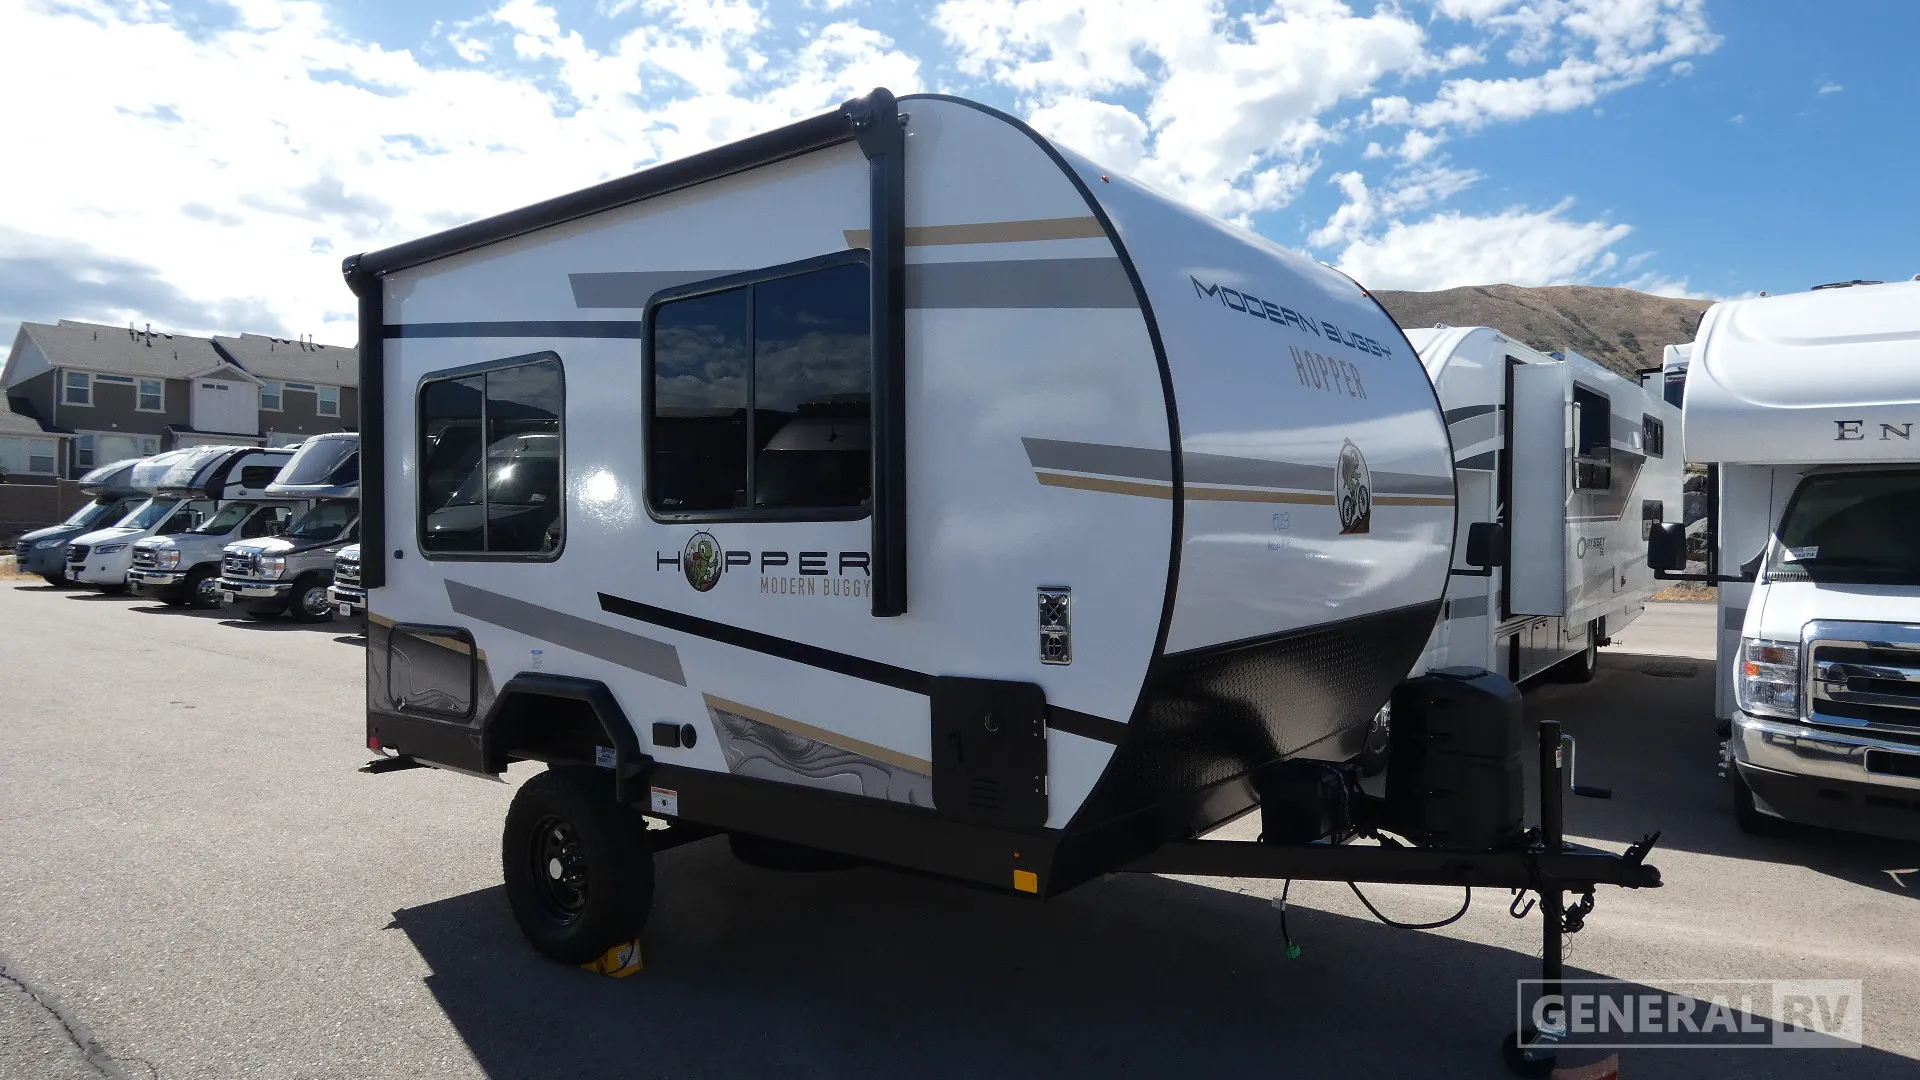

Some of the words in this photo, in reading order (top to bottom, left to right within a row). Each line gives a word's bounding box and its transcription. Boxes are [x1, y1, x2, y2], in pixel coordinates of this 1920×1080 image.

[1190, 275, 1320, 337] MODERN
[1321, 321, 1392, 360] BUGGY
[1289, 345, 1367, 400] HOPPER
[760, 576, 815, 596] MODERN
[823, 578, 871, 598] BUGGY
